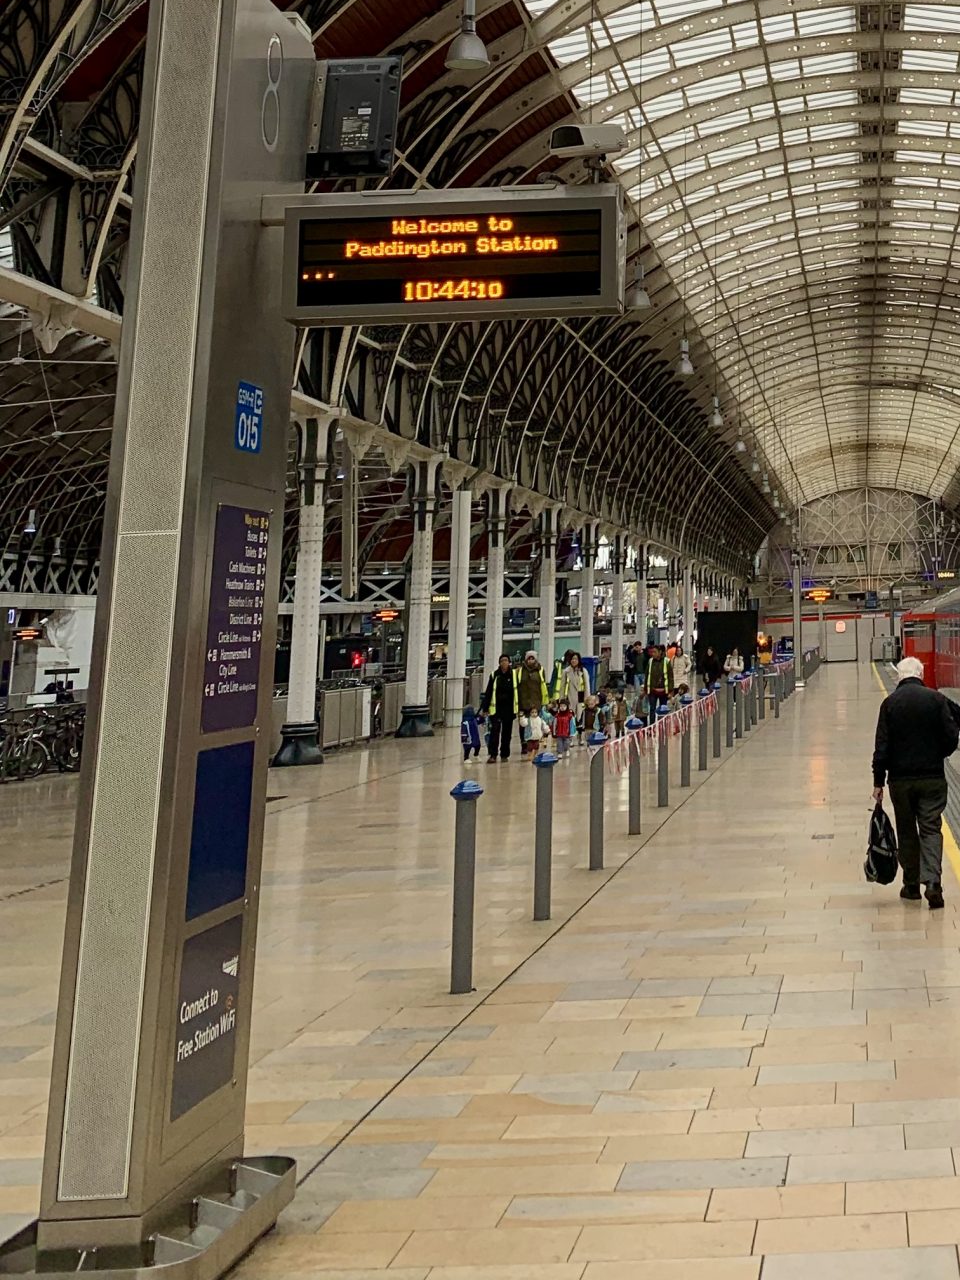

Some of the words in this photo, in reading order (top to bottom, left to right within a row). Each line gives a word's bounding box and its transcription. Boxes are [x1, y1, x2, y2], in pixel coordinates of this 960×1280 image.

[391, 219, 478, 236] Welcome
[488, 216, 513, 231] to
[345, 239, 467, 258] Paddington
[475, 236, 558, 254] Station
[404, 279, 503, 301] 10:44:10
[238, 412, 259, 450] 015
[247, 530, 258, 543] Buses
[245, 546, 257, 558] Toilets
[229, 561, 239, 573] Cash
[239, 563, 256, 574] Machines
[225, 578, 244, 590] Heathrow
[244, 579, 255, 591] Trains
[229, 613, 244, 625] District
[244, 614, 252, 625] Line
[218, 631, 230, 643] Circle
[230, 631, 239, 643] Line
[220, 648, 248, 660] Hammersmith
[219, 664, 228, 679] City
[228, 664, 237, 676] Line
[217, 681, 230, 694] Circle
[230, 680, 239, 693] Line
[180, 990, 210, 1024] Connect
[210, 988, 219, 1007] to
[177, 1039, 194, 1062] Free
[193, 1022, 220, 1052] Station
[220, 1008, 236, 1036] WiFi
